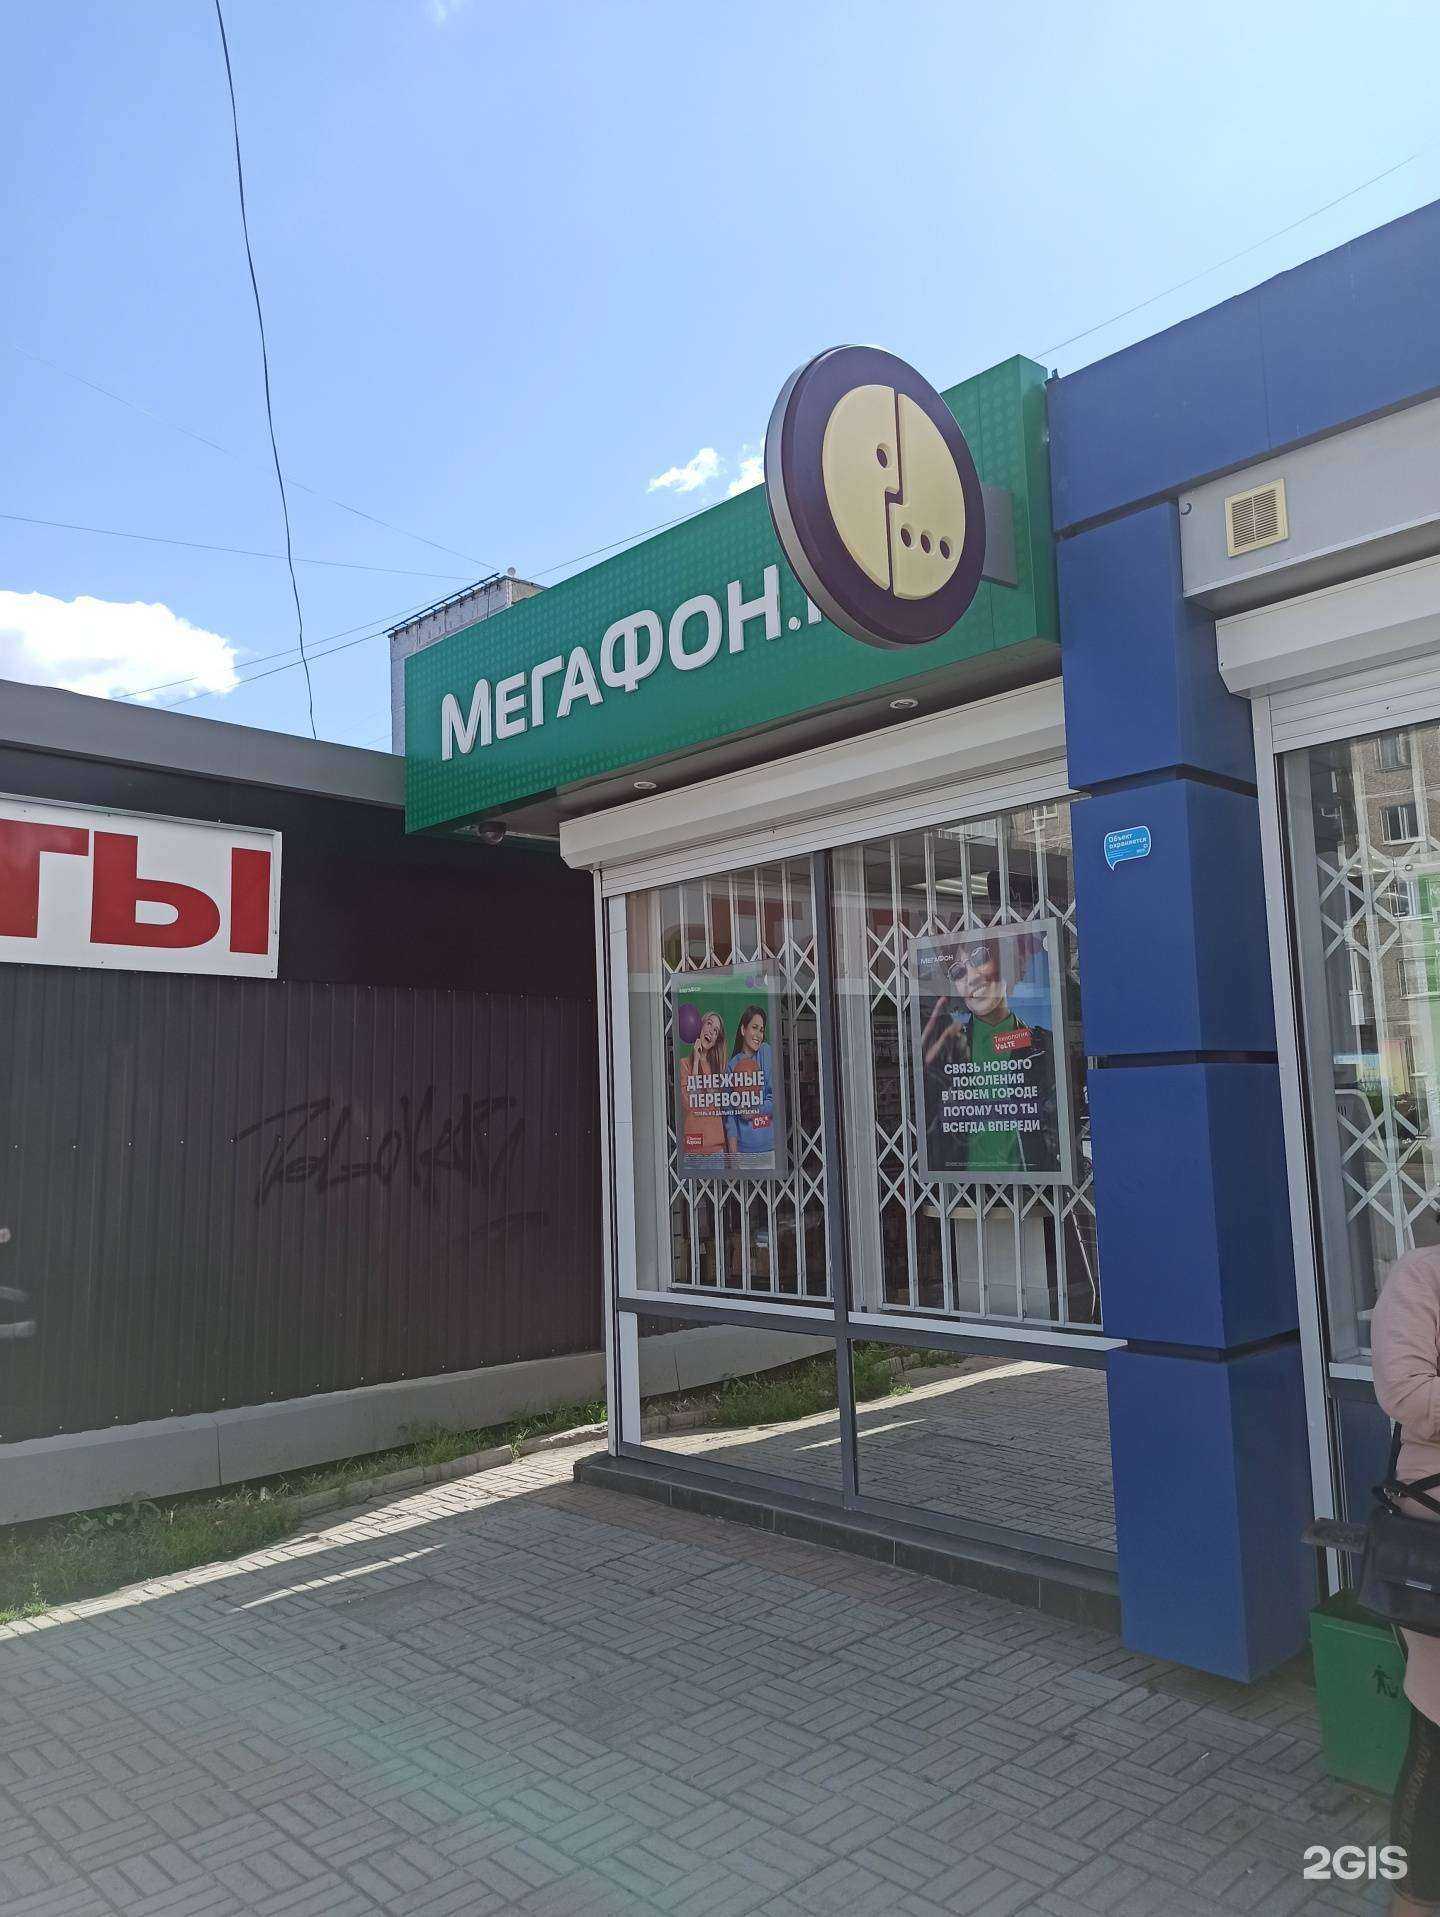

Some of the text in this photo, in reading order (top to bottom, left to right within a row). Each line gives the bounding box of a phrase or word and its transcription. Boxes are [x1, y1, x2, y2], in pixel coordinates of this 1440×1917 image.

[441, 563, 822, 761] МЕГАФОН.
[944, 1058, 1032, 1075] СВЯЗЬ НОВОГО
[687, 1071, 765, 1092] ДЕНЕЖНЫЕ
[953, 1072, 1025, 1087] ПОКОЛЕНИЯ
[689, 1090, 764, 1108] ПЕРЕВОДЫ
[941, 1085, 1038, 1101] В ТВОЕМ ГОРОДЕ
[943, 1102, 1038, 1117] ПОТОМУ ЧТО ТЫ
[943, 1119, 1041, 1133] ВСЕГДА ВПЕРЕДИ
